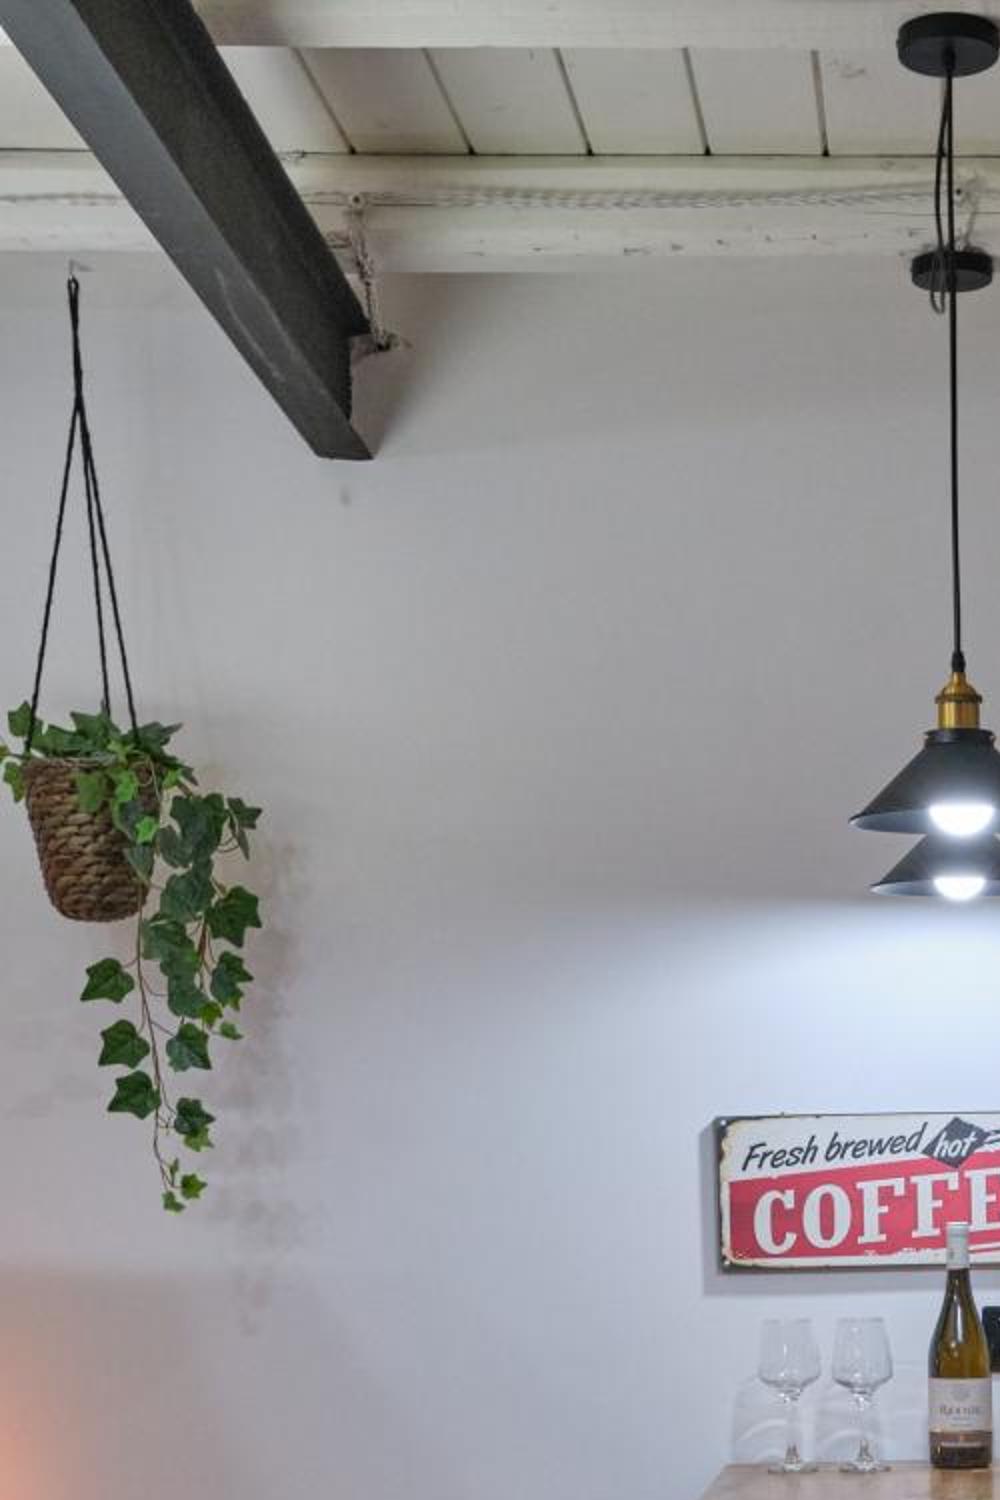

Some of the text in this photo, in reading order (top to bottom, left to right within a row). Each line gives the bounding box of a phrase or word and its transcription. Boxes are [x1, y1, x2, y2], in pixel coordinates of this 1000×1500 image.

[741, 1121, 929, 1172] Fresh brewed
[932, 1131, 977, 1160] hot
